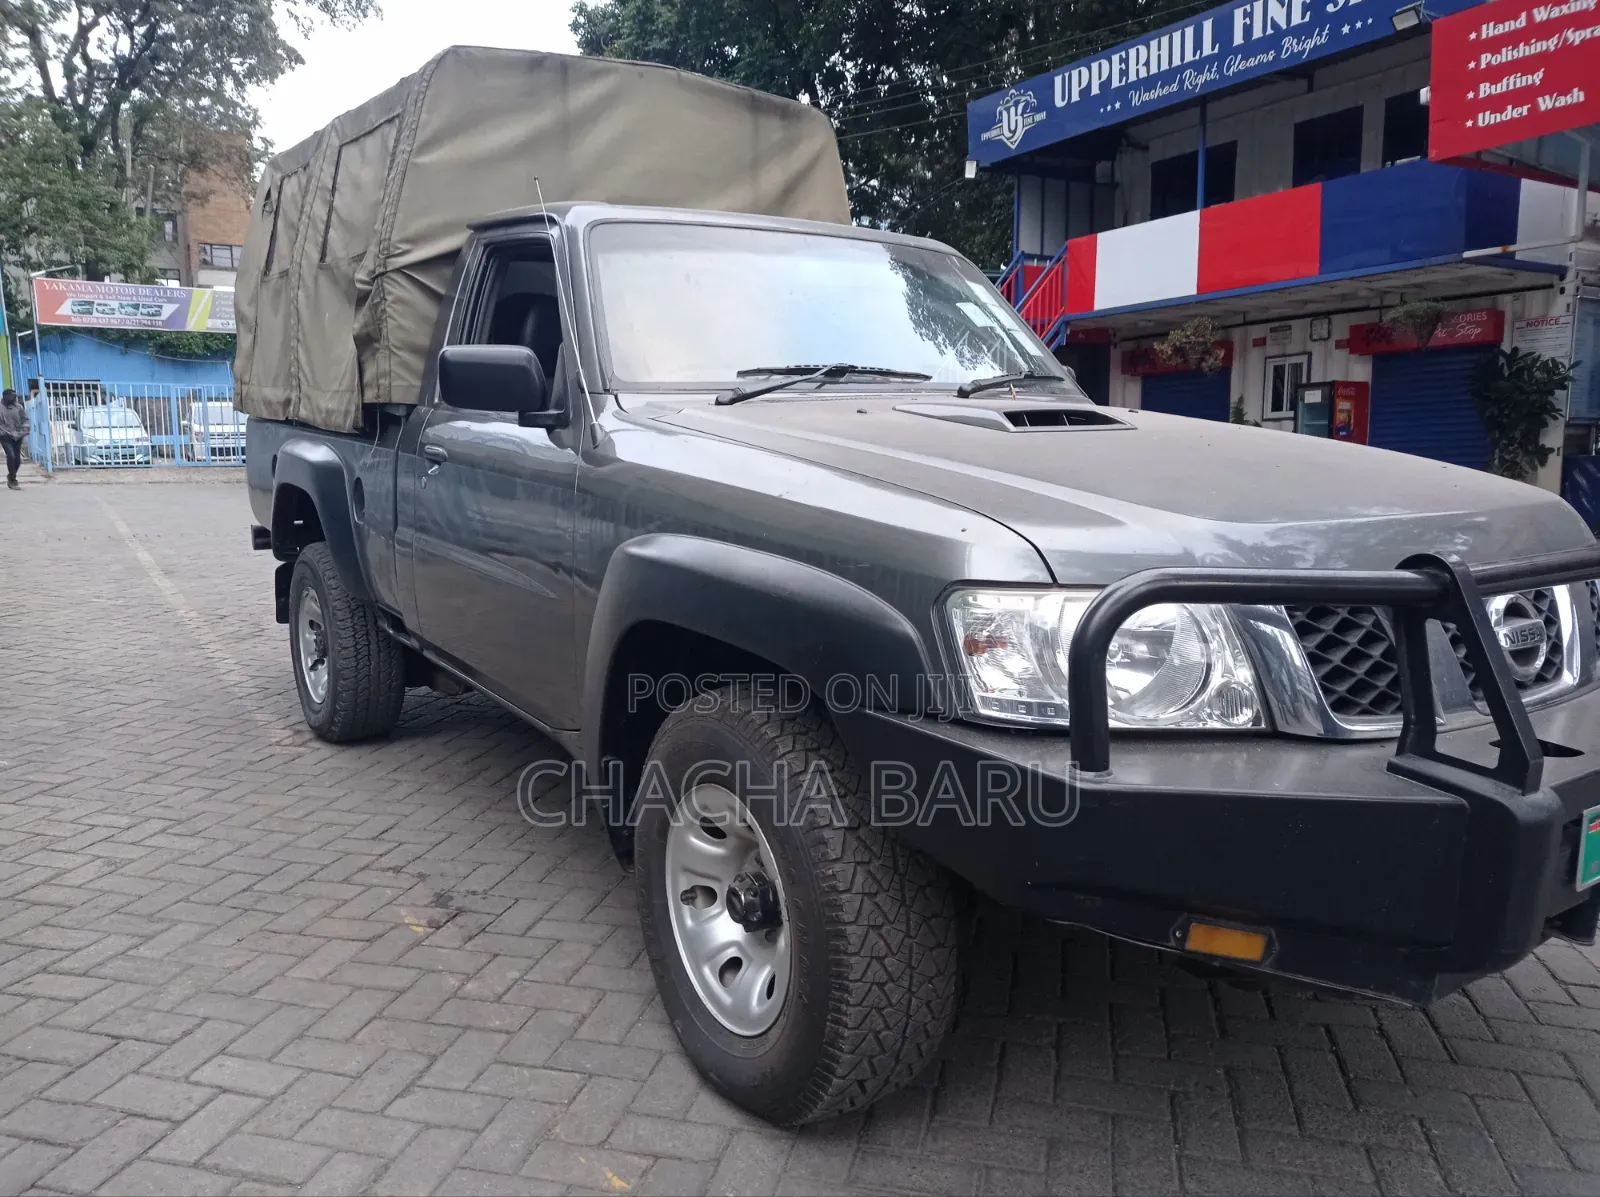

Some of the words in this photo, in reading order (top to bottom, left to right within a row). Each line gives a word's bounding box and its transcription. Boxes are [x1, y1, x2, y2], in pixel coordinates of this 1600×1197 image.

[1480, 11, 1527, 40] Hand
[1532, 0, 1598, 23] Waxing
[1054, 17, 1219, 108] UPPERHILL
[1232, 0, 1310, 47] FINE
[1128, 74, 1180, 107] Washed
[1182, 61, 1220, 92] Right,
[1223, 50, 1276, 76] Gleams
[1280, 23, 1331, 59] Bright
[1478, 68, 1545, 99] Buffing
[1477, 104, 1531, 127] Under
[1537, 87, 1585, 112] Wash
[43, 281, 93, 293] YAKAMA
[95, 285, 136, 295] MOTOR
[138, 287, 187, 298] DEALERS
[1455, 323, 1483, 340] Stop
[1526, 318, 1560, 328] NOTICE
